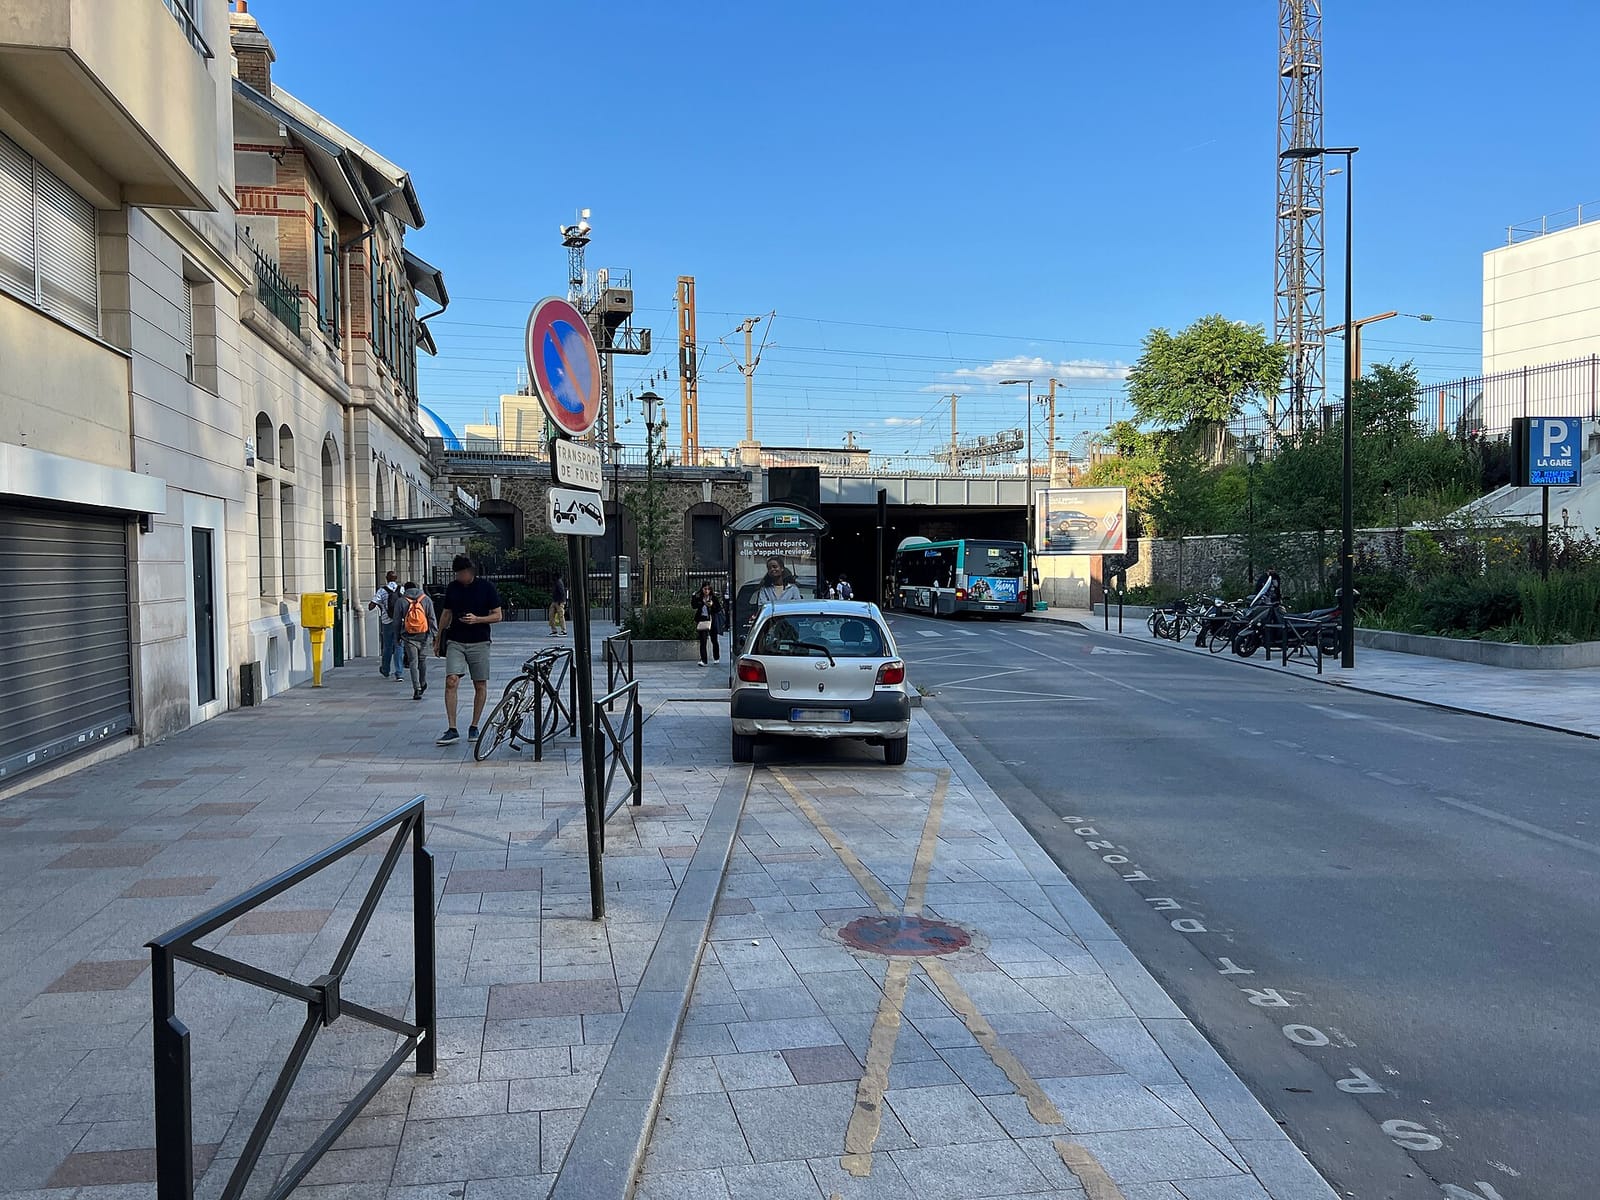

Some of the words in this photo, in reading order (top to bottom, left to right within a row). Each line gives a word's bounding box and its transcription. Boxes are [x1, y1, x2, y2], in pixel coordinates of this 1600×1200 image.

[1543, 419, 1568, 457] P
[557, 445, 600, 466] TRANSPORT
[1537, 459, 1548, 467] LA
[1549, 459, 1572, 467] GARE
[561, 465, 571, 478] DE
[575, 467, 599, 484] FONDS
[1061, 815, 1151, 882] FONDS
[1145, 897, 1208, 933] DE
